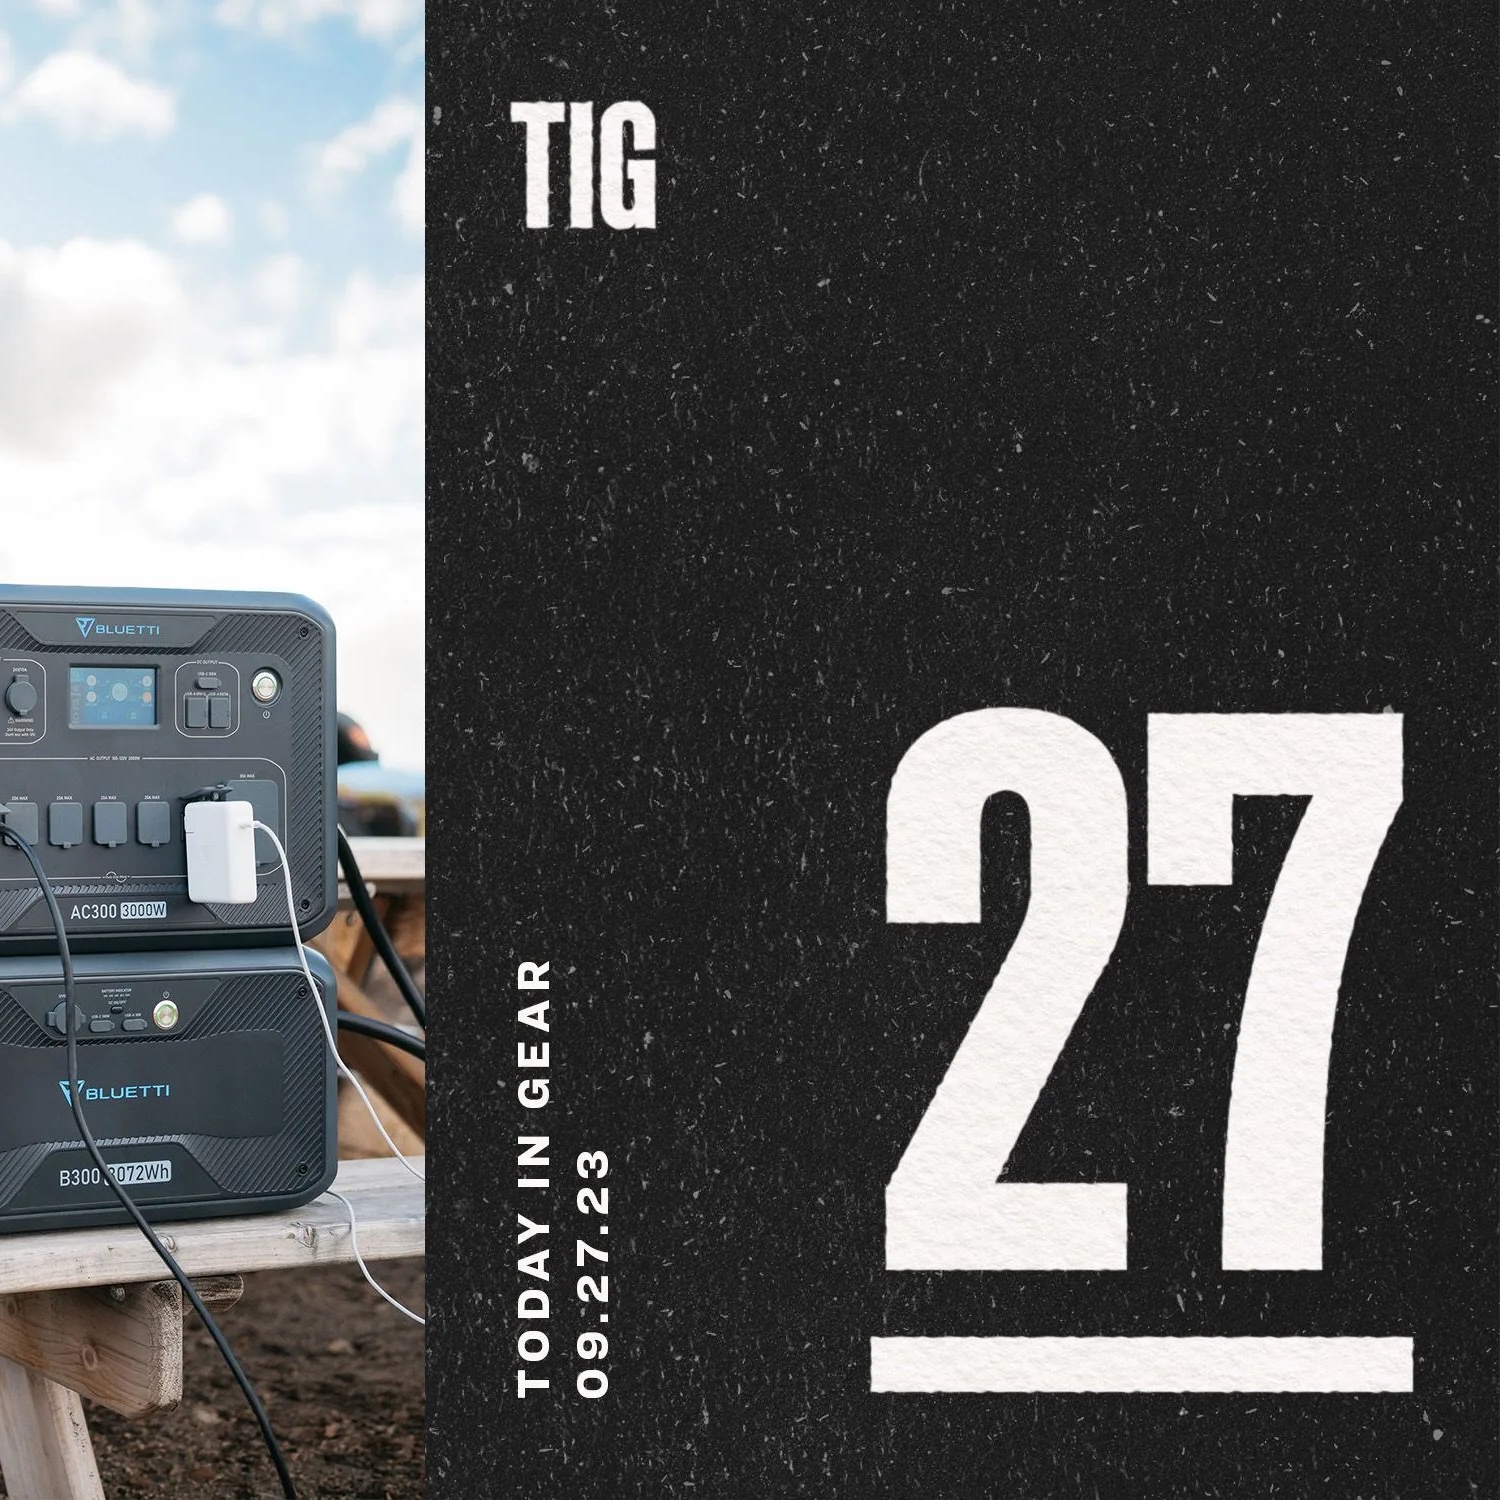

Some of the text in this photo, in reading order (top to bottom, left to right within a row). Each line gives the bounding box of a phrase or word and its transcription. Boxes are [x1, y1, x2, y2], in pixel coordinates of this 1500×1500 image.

[95, 625, 160, 635] BLUETTI
[70, 903, 165, 919] AC300 3000W
[86, 1085, 170, 1100] BLUETTI
[60, 1168, 100, 1187] B300
